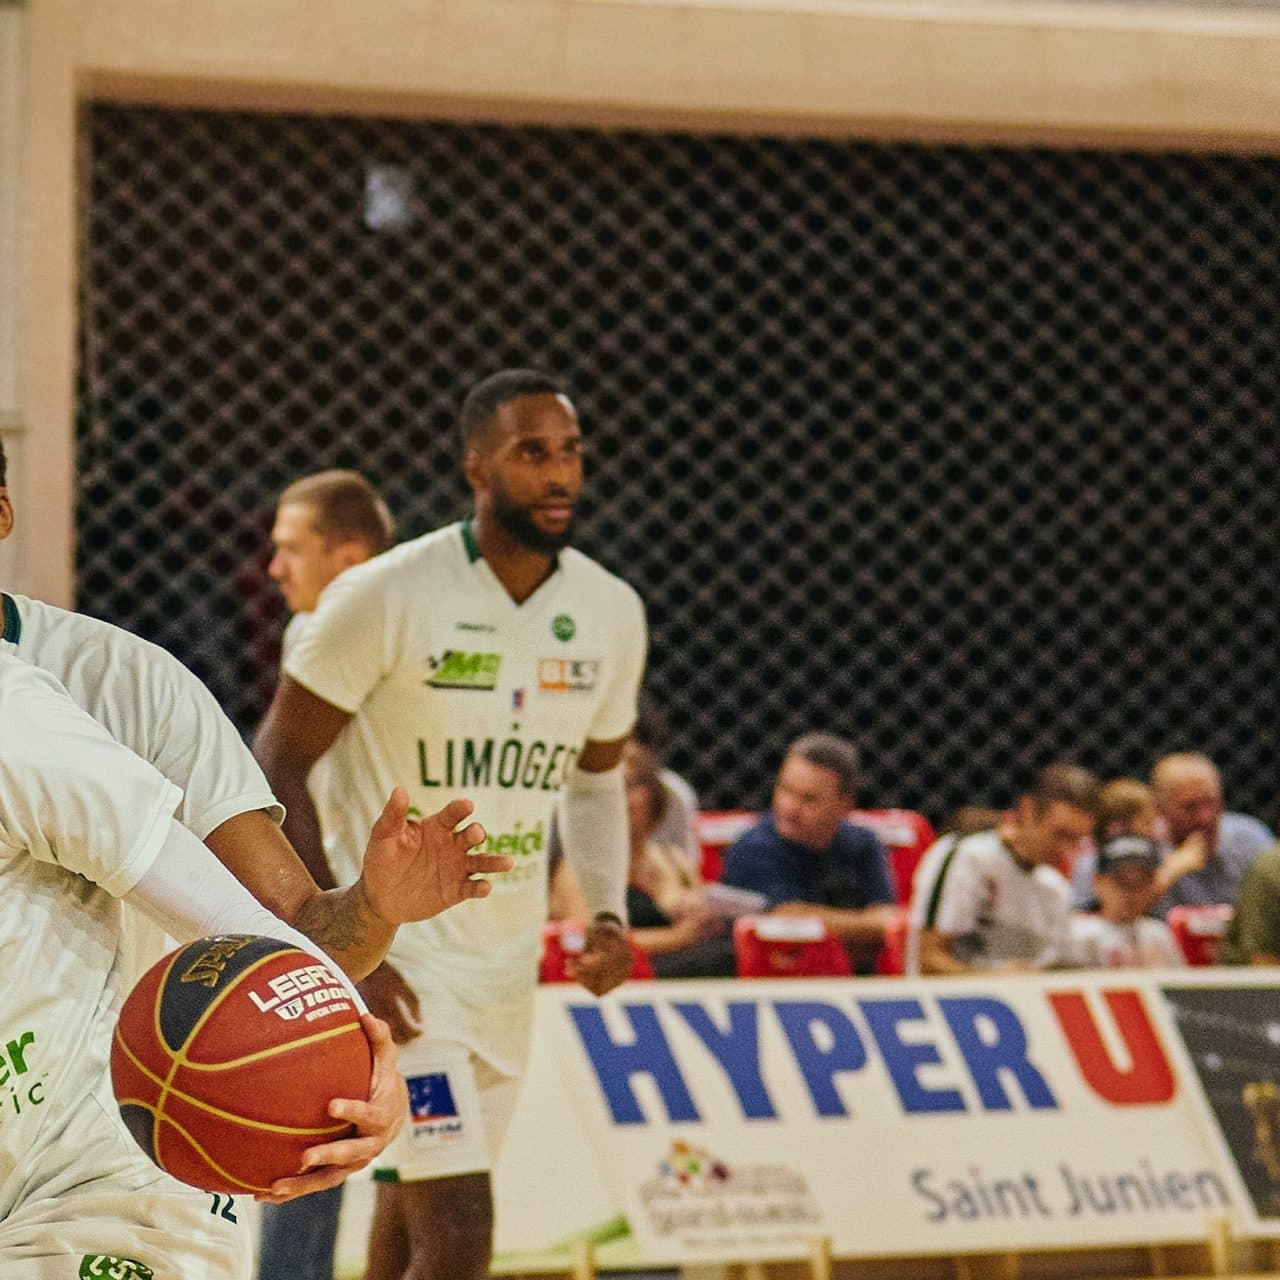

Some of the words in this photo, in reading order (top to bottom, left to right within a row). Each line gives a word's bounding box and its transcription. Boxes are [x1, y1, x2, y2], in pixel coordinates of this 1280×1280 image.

[248, 965, 340, 1013] LEGAC
[567, 995, 1060, 1127] HYPER
[1046, 988, 1178, 1106] U
[909, 1167, 1050, 1225] Saint
[1057, 1159, 1235, 1218] Junien
